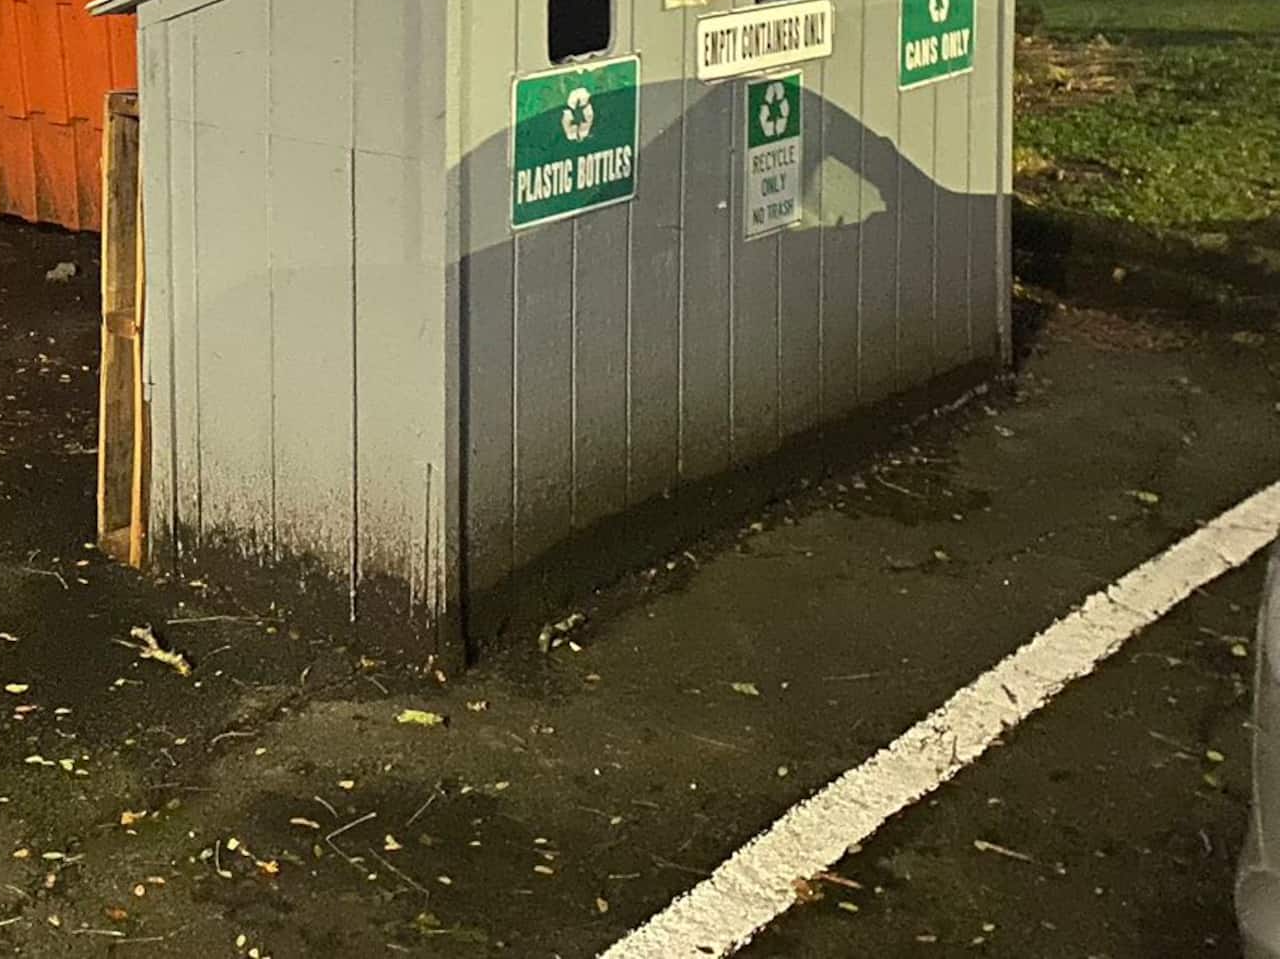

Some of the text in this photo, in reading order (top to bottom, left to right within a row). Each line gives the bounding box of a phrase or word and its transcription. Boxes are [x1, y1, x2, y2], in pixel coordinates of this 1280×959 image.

[704, 11, 826, 67] EMPTY CONTAINERS ONLY
[905, 27, 971, 71] CANS ONLY
[517, 144, 633, 205] PLASTIC BOTTLES
[752, 144, 795, 176] RECYCLE
[761, 173, 786, 197] ONLY
[752, 197, 795, 225] NO TRASH
